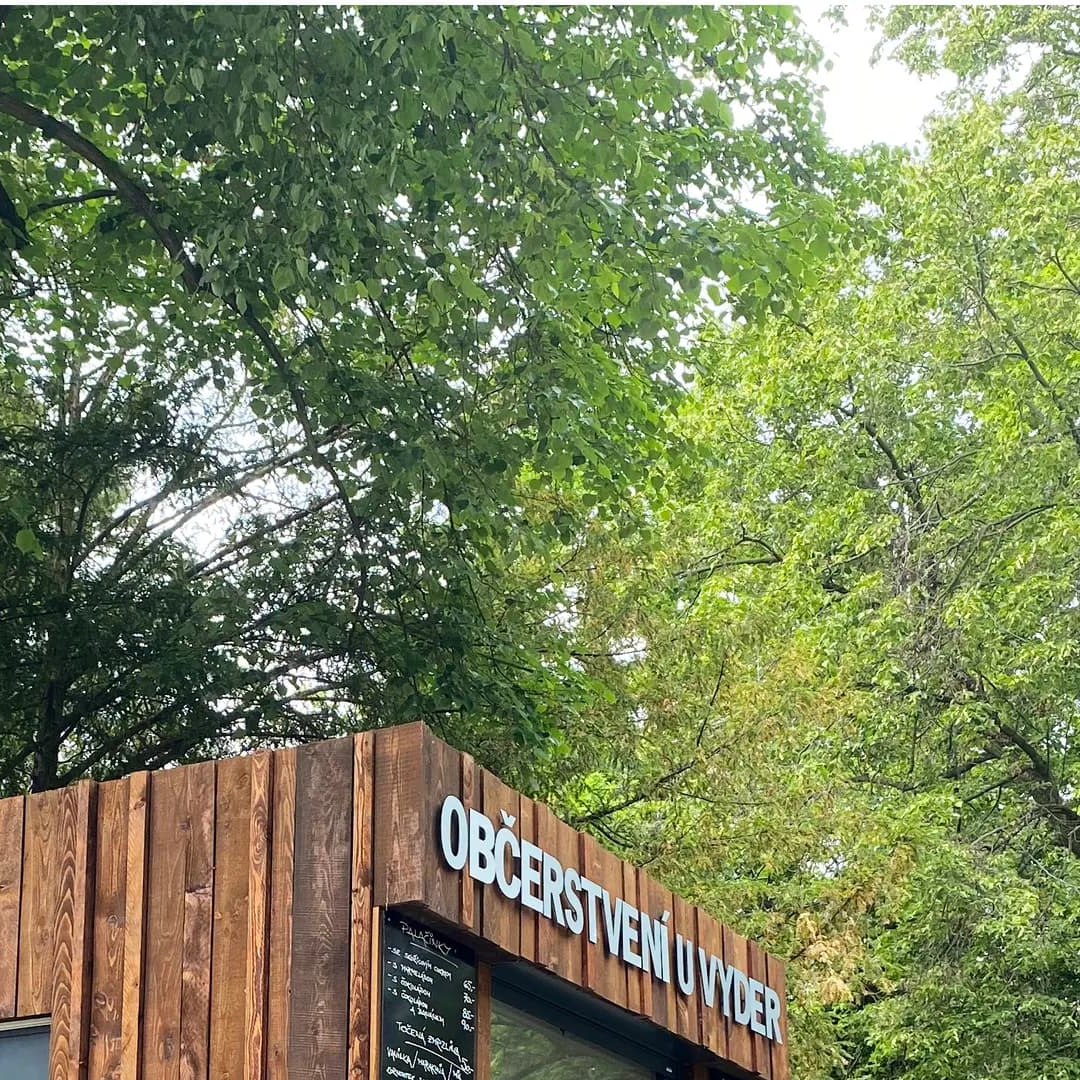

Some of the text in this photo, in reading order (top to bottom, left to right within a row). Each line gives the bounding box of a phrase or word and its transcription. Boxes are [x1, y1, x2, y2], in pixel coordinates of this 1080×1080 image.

[441, 795, 783, 1044] OBČERSTVENÍ U VYDER
[396, 1022, 426, 1046] TOČENÁ
